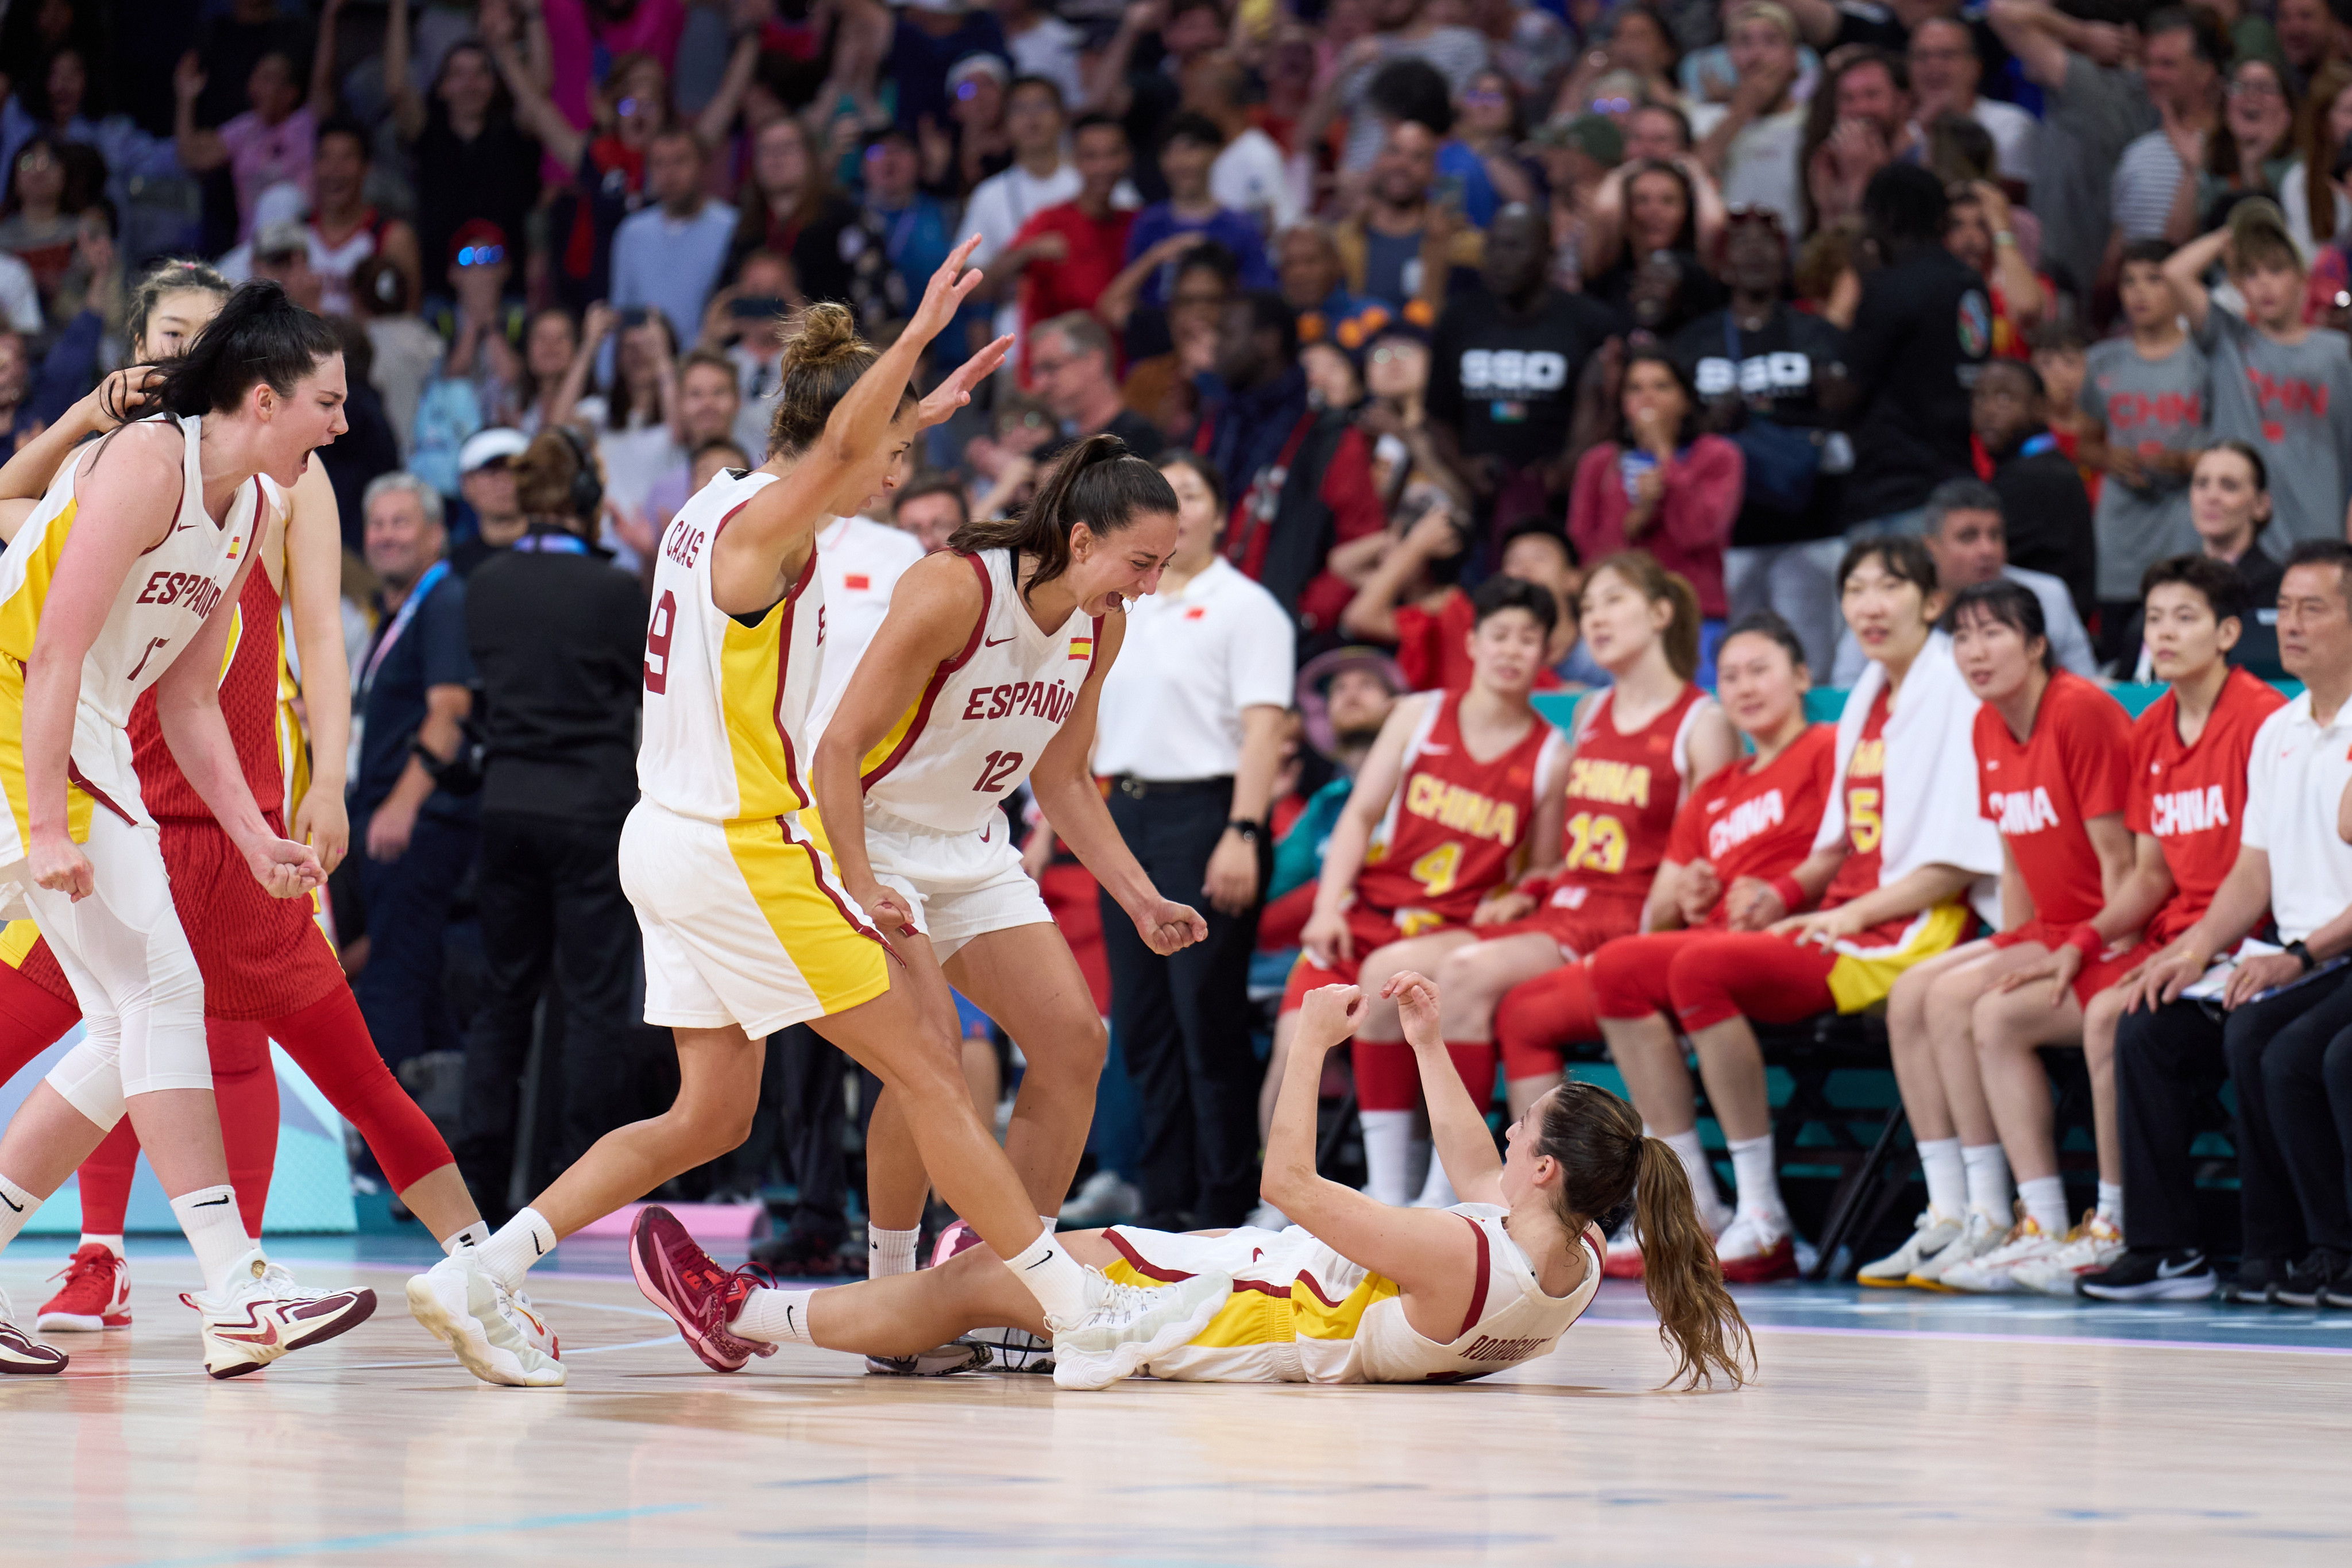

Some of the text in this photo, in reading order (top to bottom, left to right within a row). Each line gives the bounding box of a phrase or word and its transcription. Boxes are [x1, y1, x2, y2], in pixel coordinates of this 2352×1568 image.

[2108, 390, 2202, 430] CHN
[667, 520, 704, 569] CAAS
[644, 589, 677, 696] 9
[962, 678, 1074, 724] ESPAÑA
[972, 750, 1024, 792] 12
[1405, 772, 1518, 847] CHINA
[1848, 787, 1882, 853] 5
[2150, 784, 2229, 837] CHINA
[1566, 811, 1628, 870] 13
[1409, 840, 1465, 897] 4
[1458, 1335, 1553, 1361] RODRÍGUE
